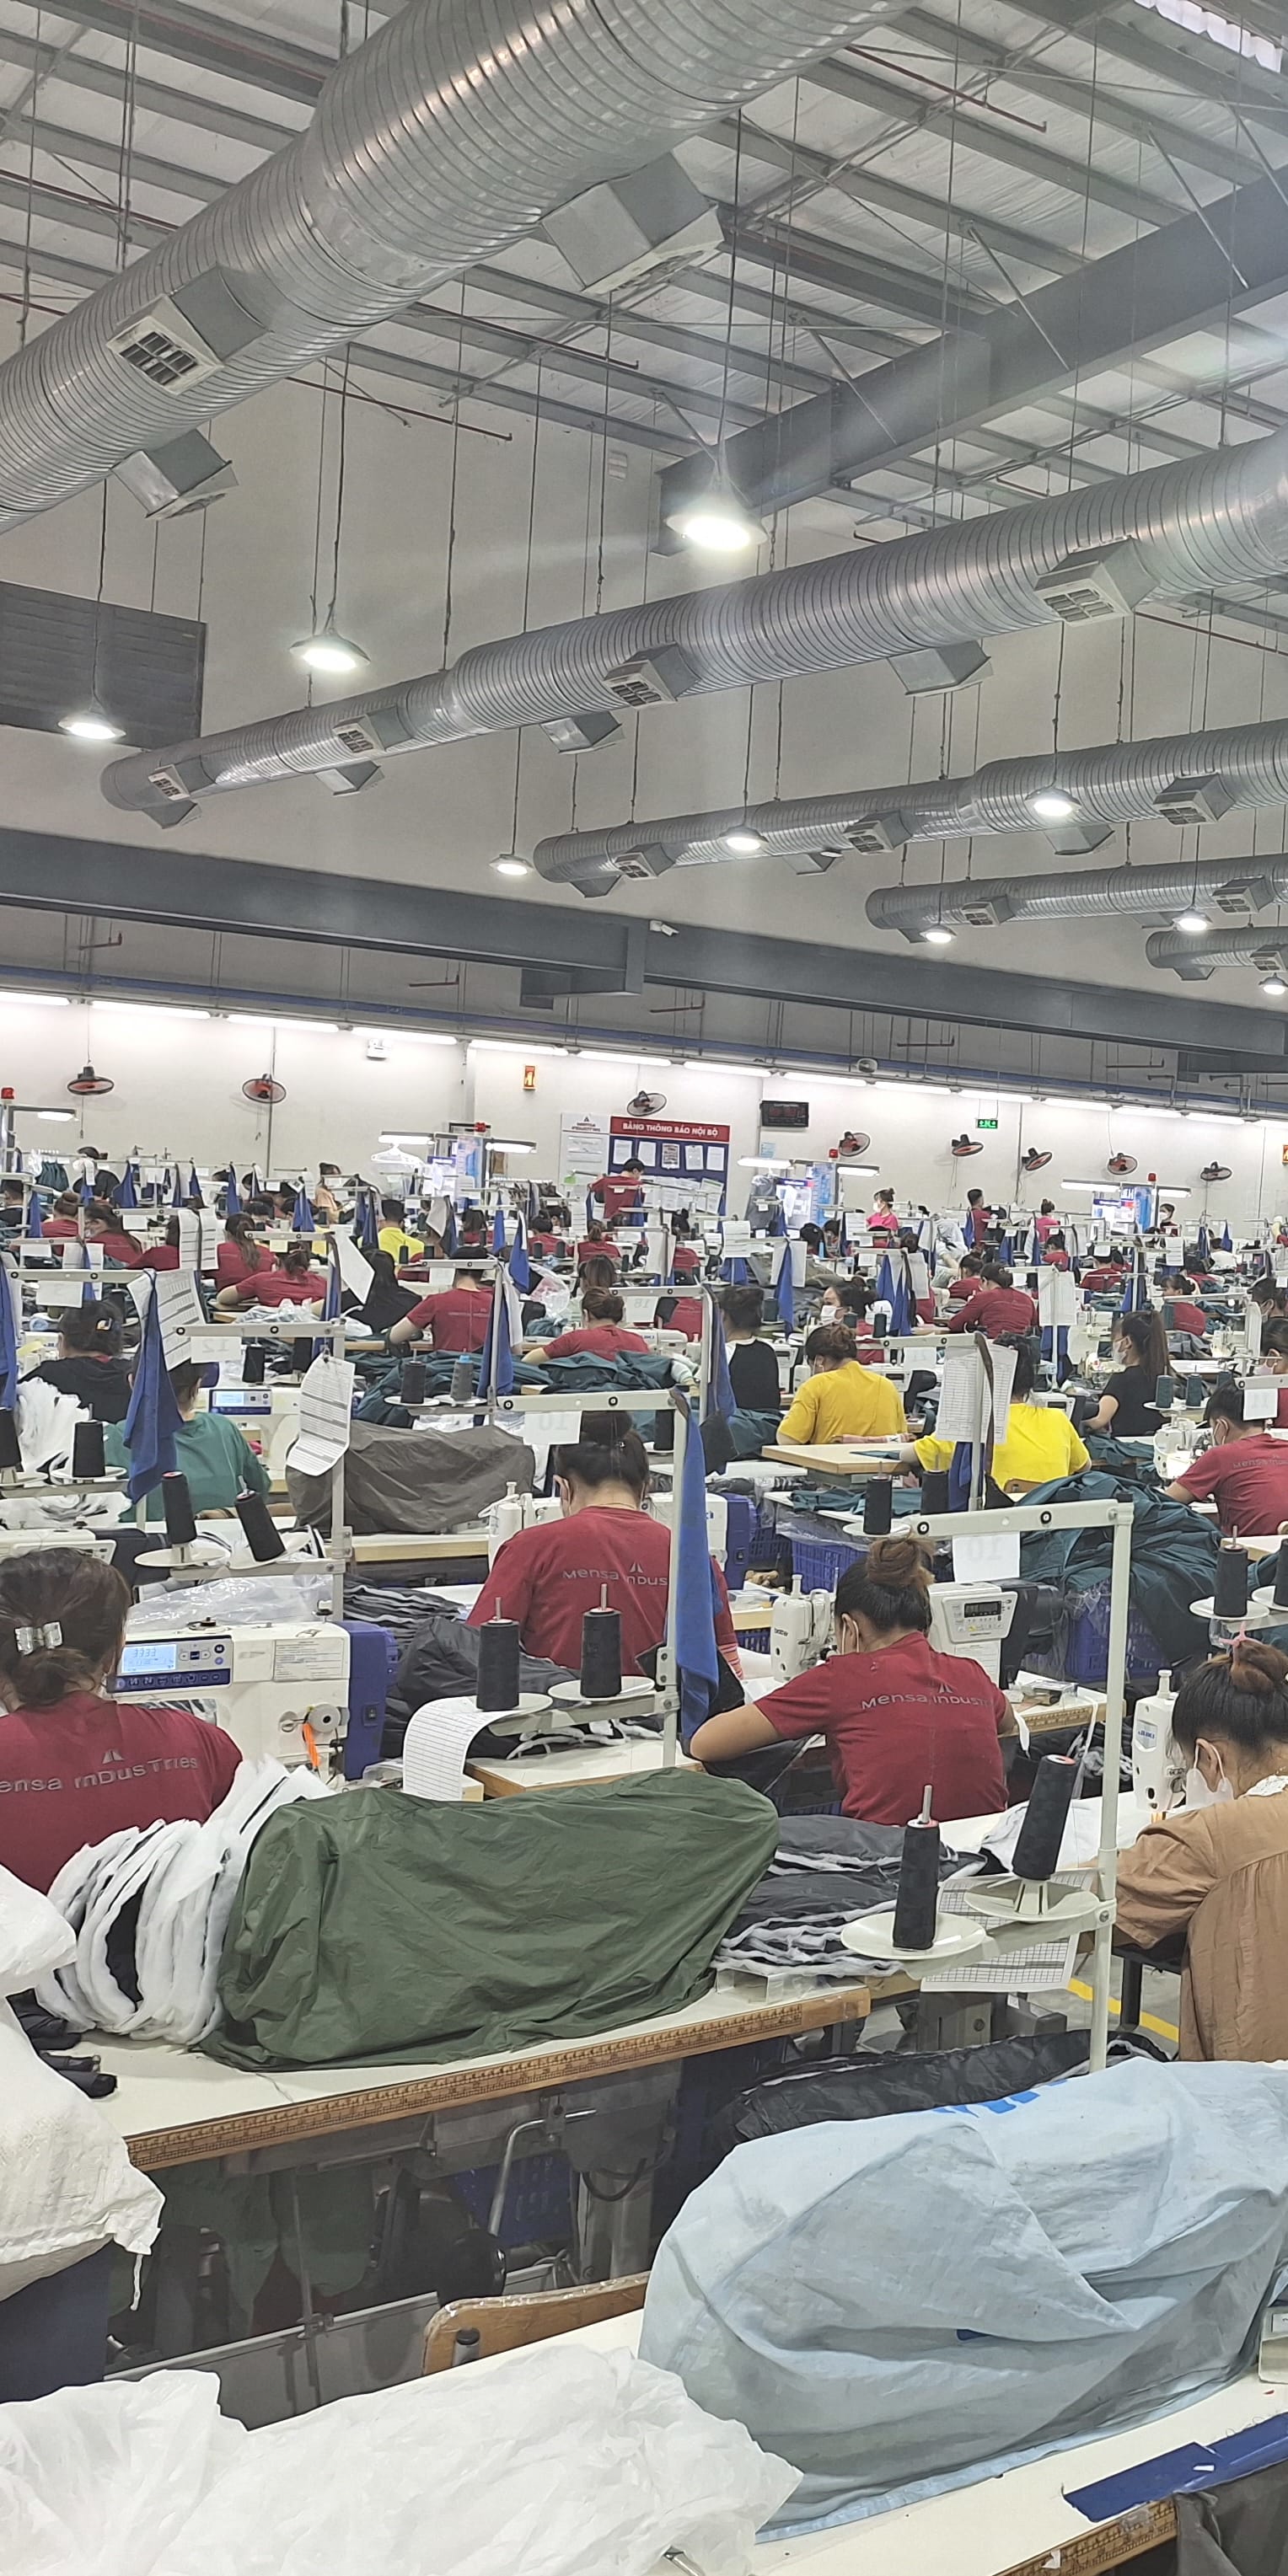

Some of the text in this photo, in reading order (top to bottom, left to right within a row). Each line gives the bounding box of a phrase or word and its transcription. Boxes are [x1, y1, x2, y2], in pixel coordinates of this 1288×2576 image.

[622, 1121, 718, 1138] BẢNG THÔNG BÁO NỘI BỘ
[0, 1776, 63, 1793] ensa
